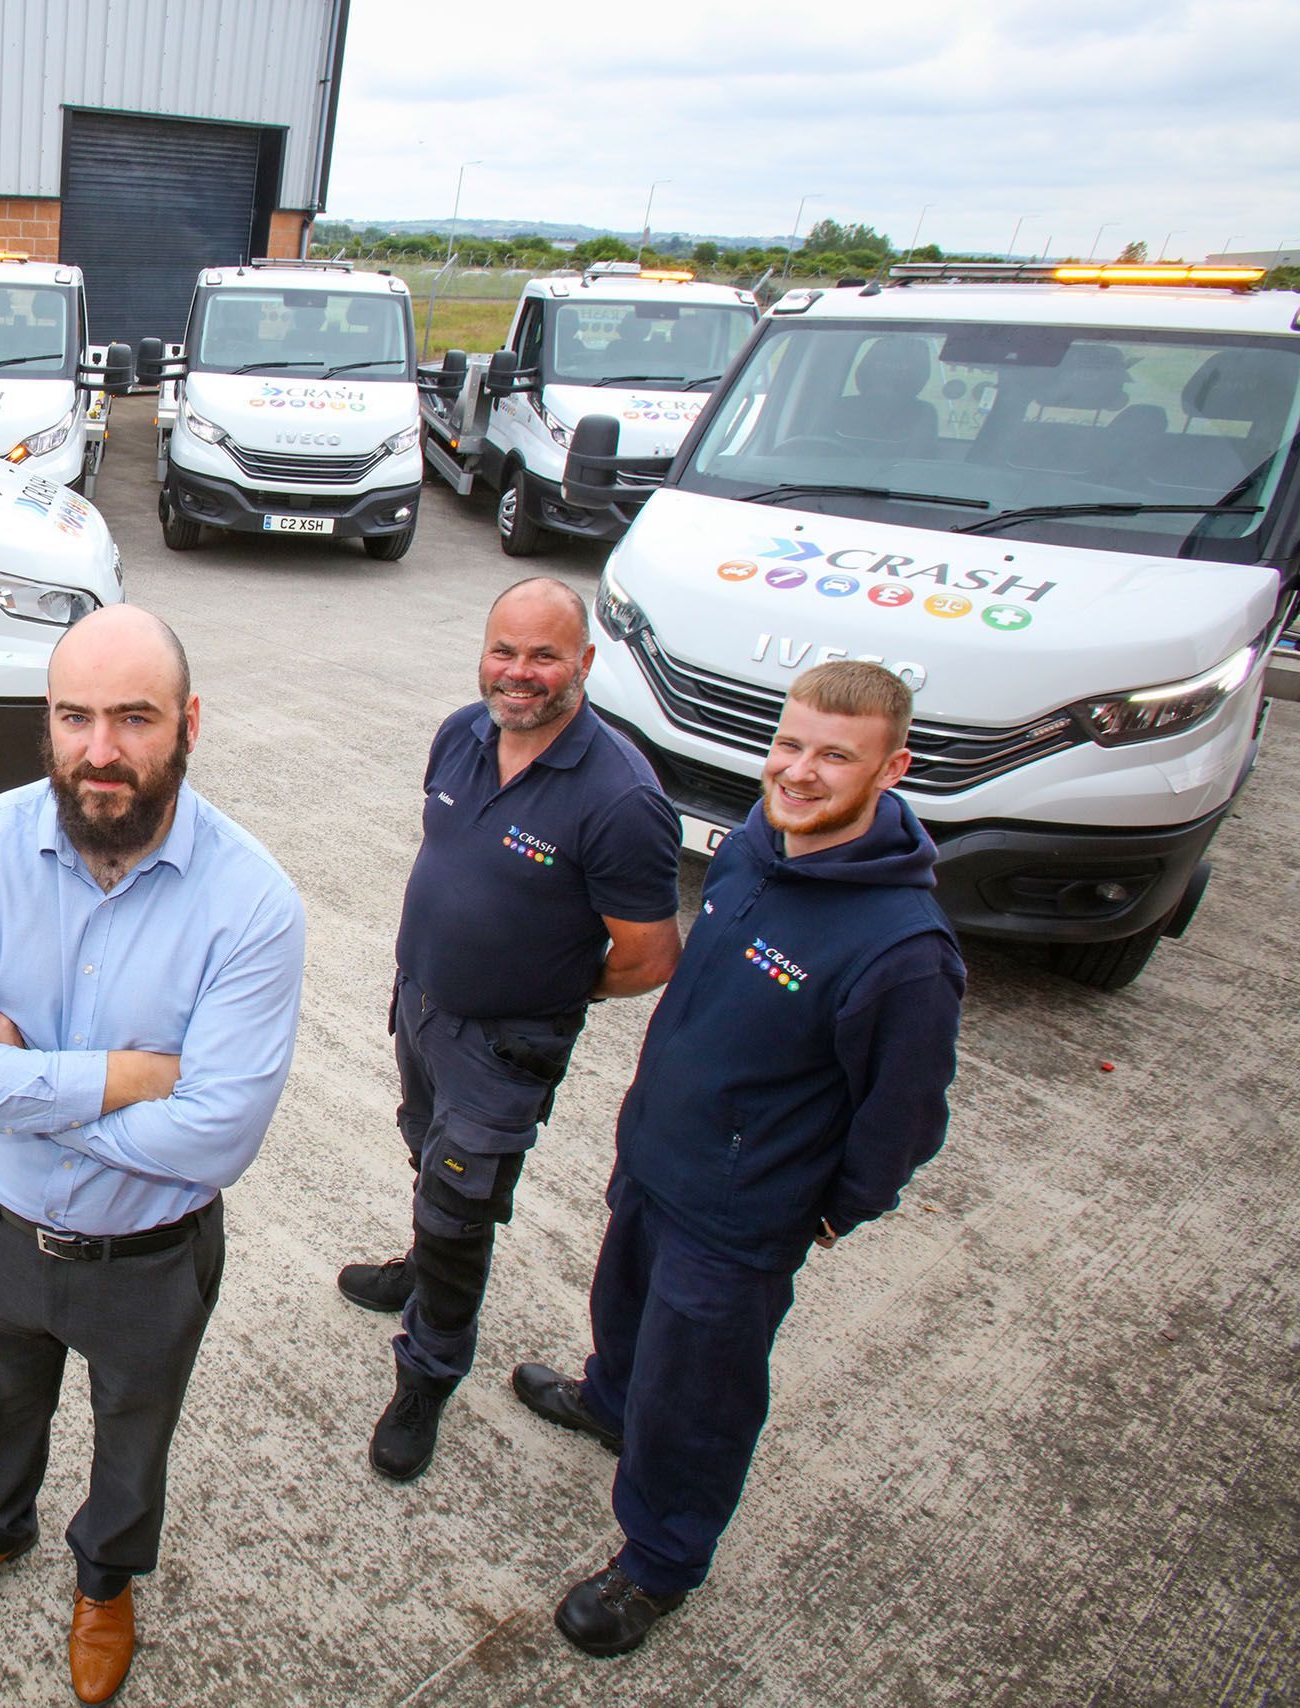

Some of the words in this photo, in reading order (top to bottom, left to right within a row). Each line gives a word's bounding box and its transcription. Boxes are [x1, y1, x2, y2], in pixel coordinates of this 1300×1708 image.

[286, 388, 364, 400] CRASH
[657, 400, 702, 410] CRA
[276, 432, 341, 446] IVECO
[280, 518, 296, 530] C2
[300, 519, 324, 531] XSH
[826, 549, 1057, 602] CRASH
[751, 633, 928, 693] IVEO
[519, 832, 557, 854] CRASH
[765, 948, 808, 981] CRASH
